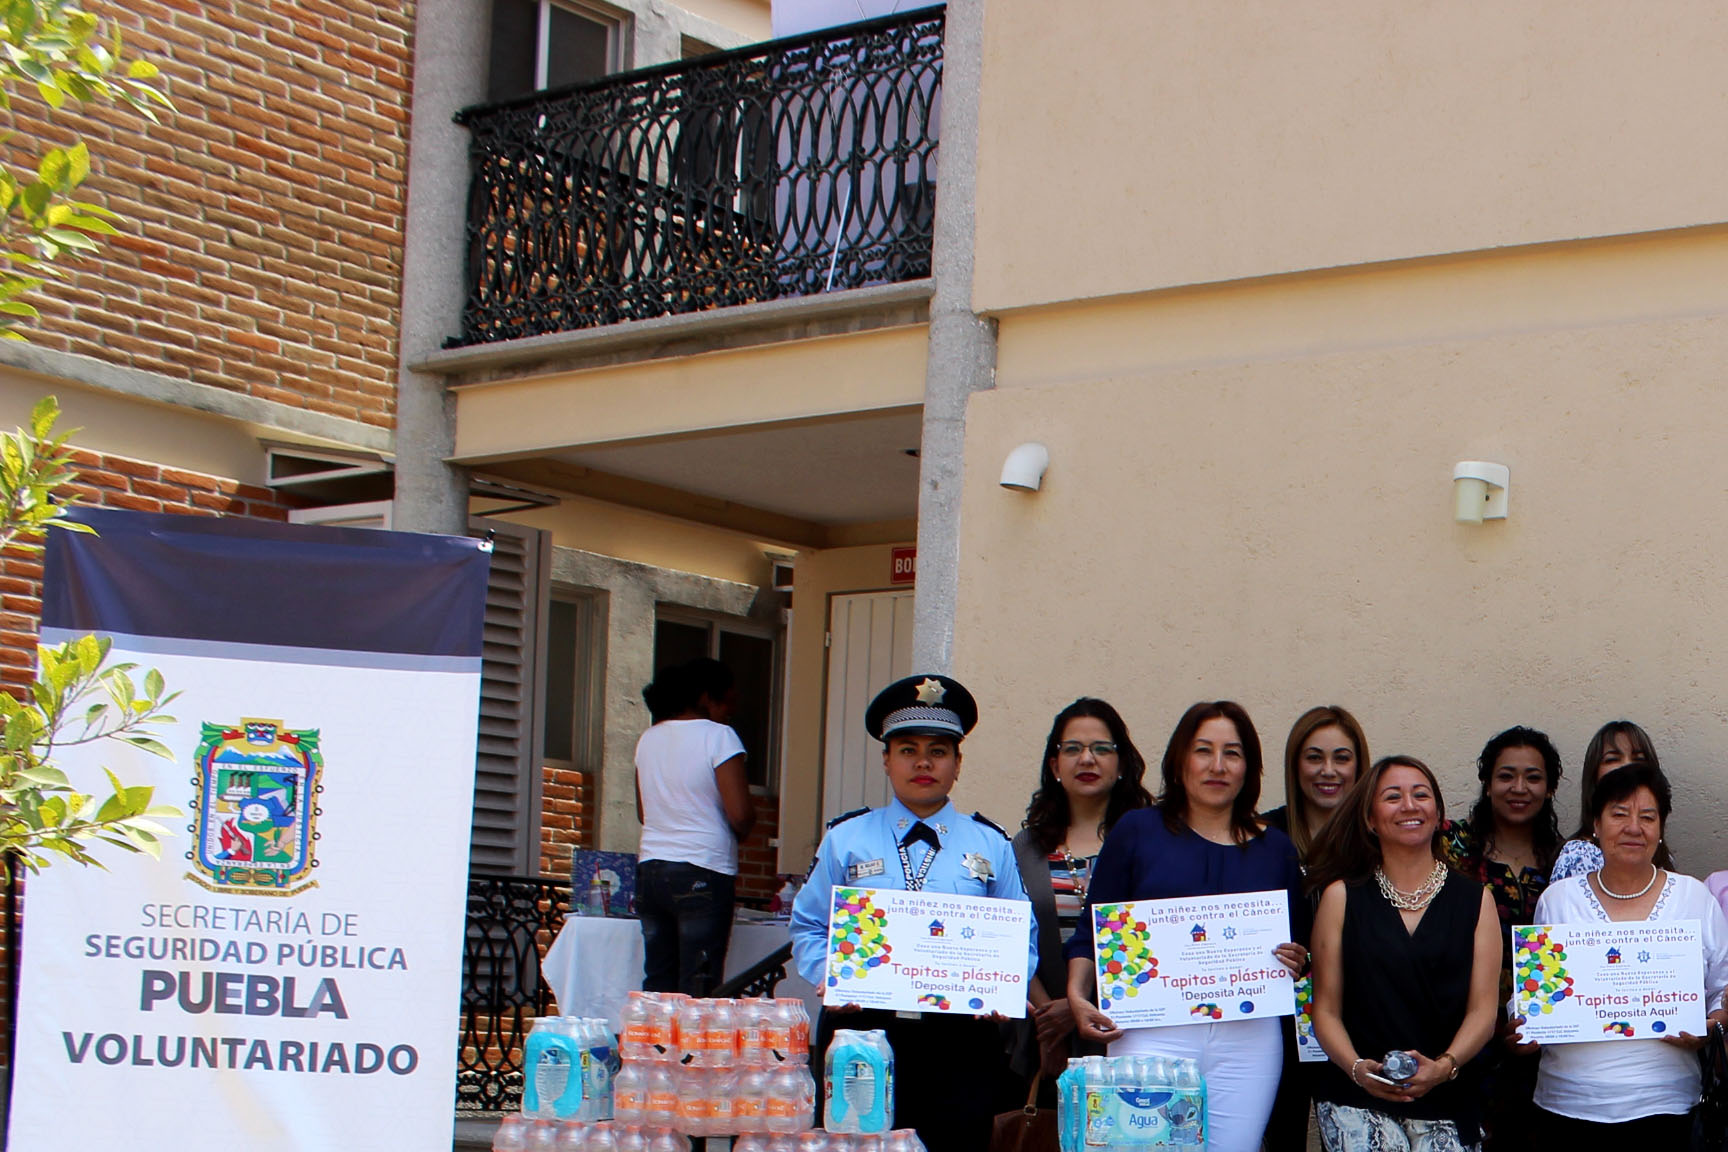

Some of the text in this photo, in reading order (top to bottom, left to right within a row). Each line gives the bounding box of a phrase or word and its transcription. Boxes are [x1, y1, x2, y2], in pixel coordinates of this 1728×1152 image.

[142, 903, 358, 936] SECRETARÍA DE
[85, 934, 408, 970] SEGURIDAD PÚBLICA
[139, 969, 349, 1019] PUEBLA
[1181, 984, 1266, 1001] !Deposita Aquí!
[1595, 1006, 1678, 1020] !Deposita Aquí!
[61, 1031, 419, 1075] VOLUNTARIADO
[1129, 1114, 1158, 1129] Agua
